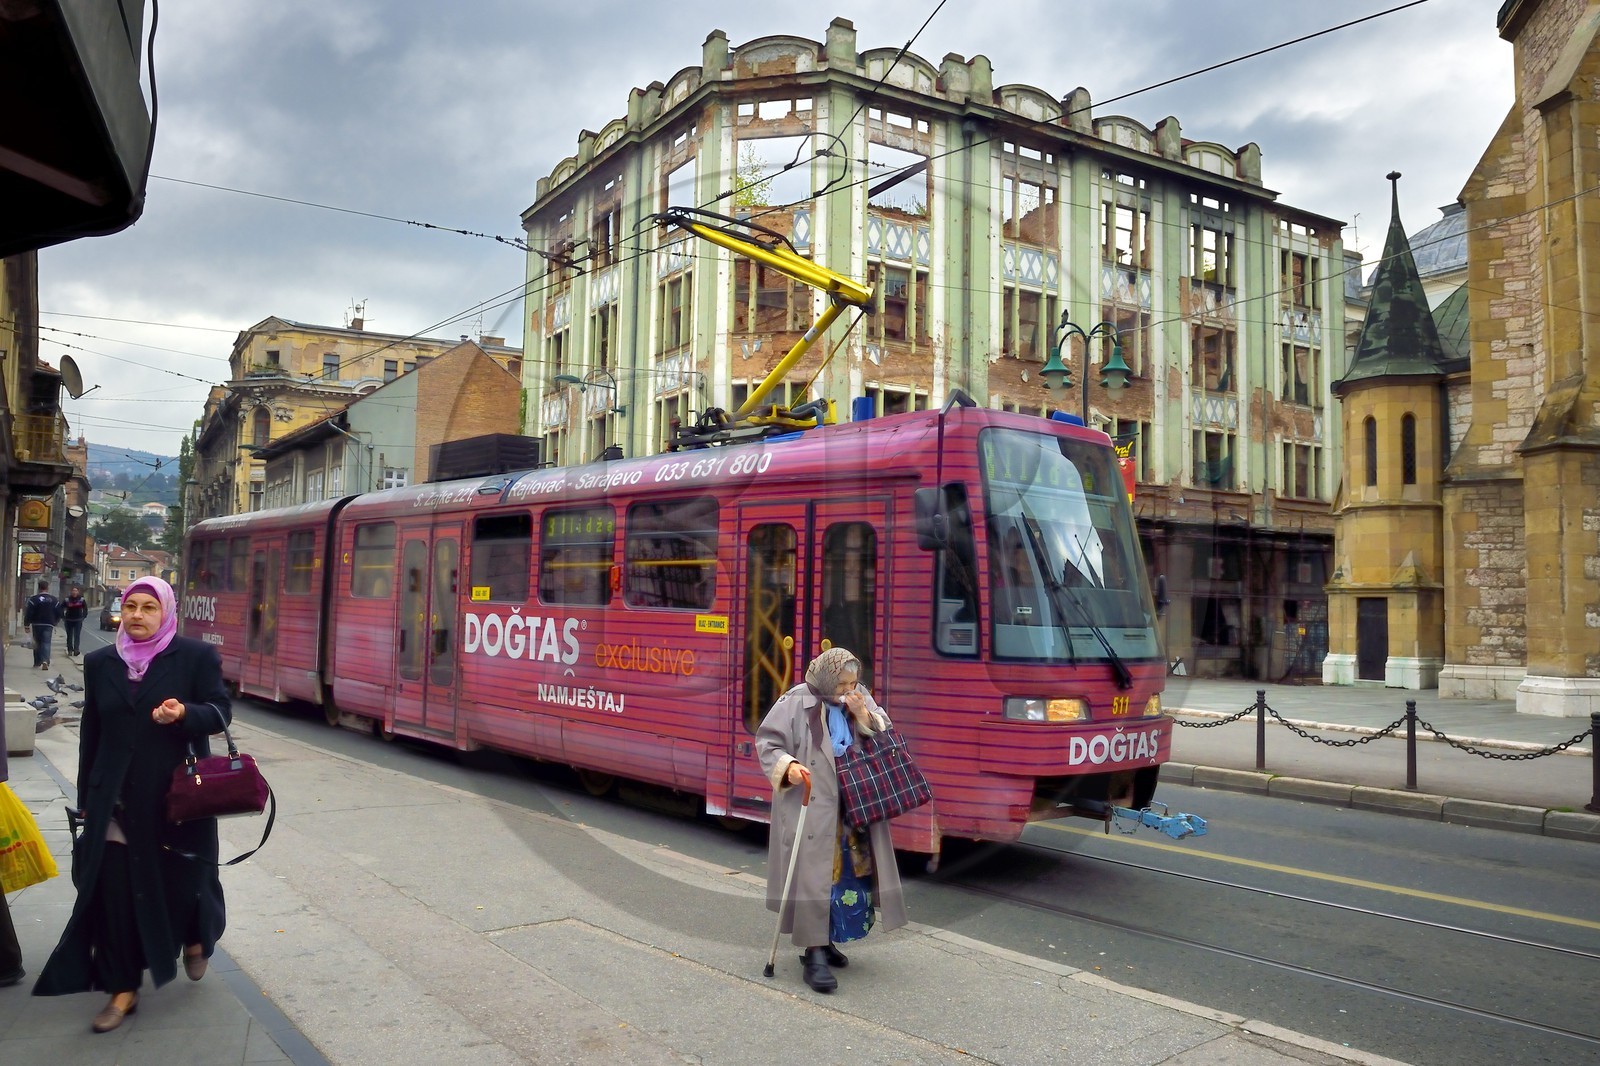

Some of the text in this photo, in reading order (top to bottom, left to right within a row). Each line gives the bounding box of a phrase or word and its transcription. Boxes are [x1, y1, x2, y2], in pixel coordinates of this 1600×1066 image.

[413, 493, 422, 507] S.
[424, 490, 454, 509] Zajke
[453, 487, 475, 505] 221,
[508, 478, 566, 500] Rajlovac
[575, 470, 642, 492] Sarajevo
[655, 461, 689, 482] 033
[691, 456, 727, 477] 631
[729, 452, 772, 475] 800
[595, 637, 695, 676] exclusive
[538, 683, 625, 713] NAMJEŠTAJ
[1112, 696, 1130, 715] 511
